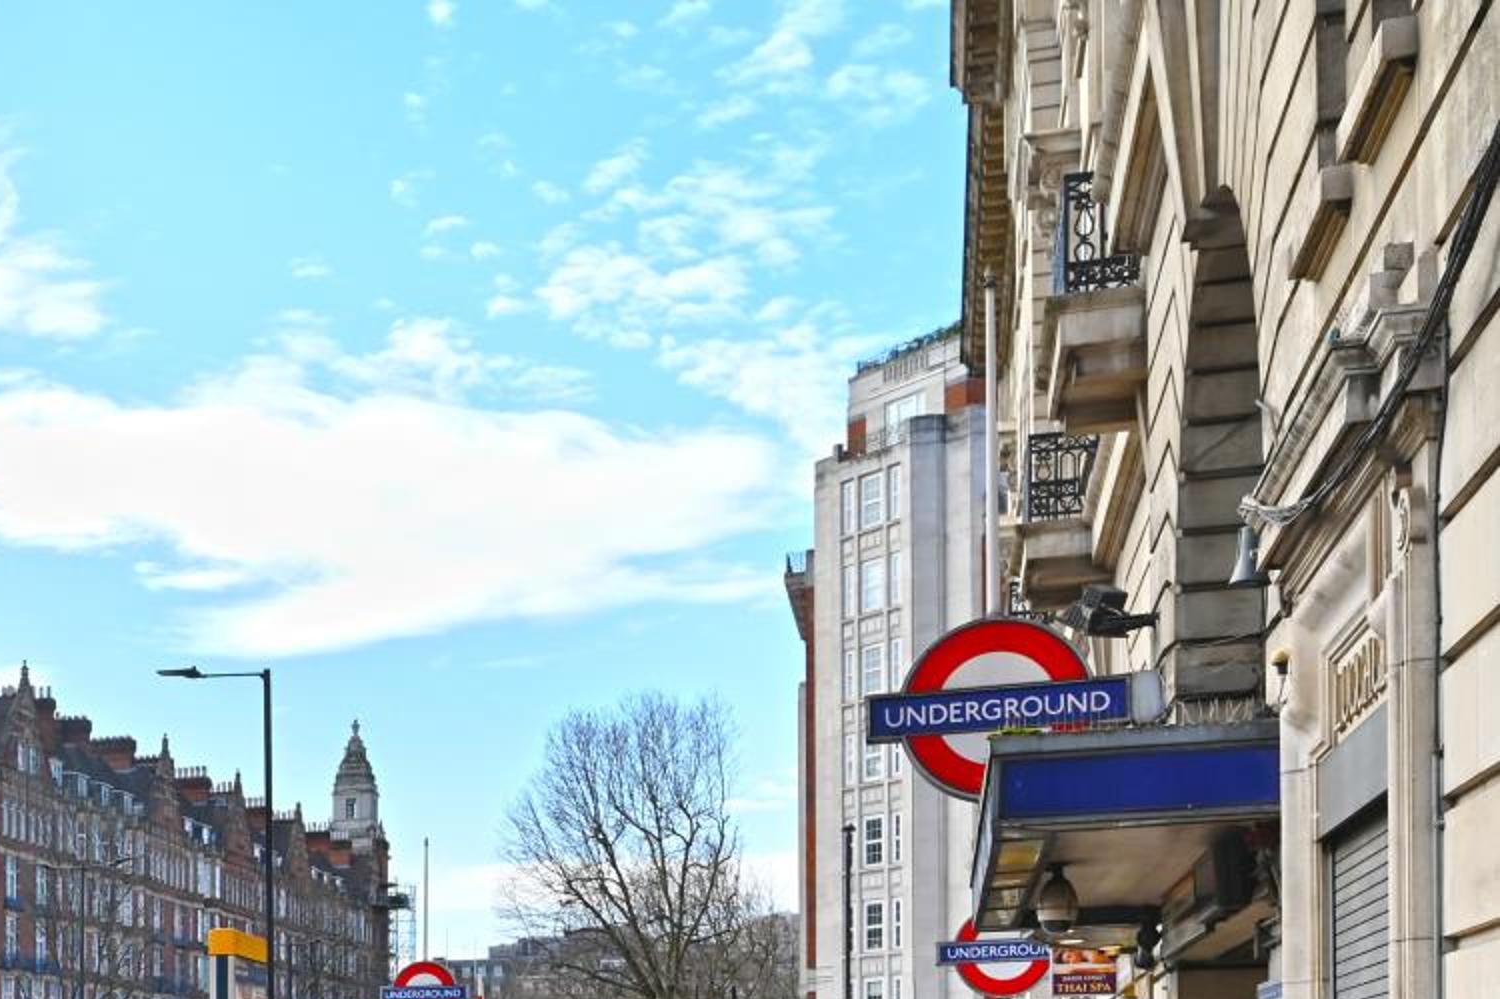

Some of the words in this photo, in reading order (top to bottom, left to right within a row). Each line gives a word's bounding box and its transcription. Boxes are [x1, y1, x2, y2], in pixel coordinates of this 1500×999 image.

[884, 690, 1111, 728] UNDERGROUND
[947, 943, 1051, 960] UNDERGROUN
[385, 988, 461, 999] UNDERGROUND
[1058, 983, 1087, 993] THAI
[1089, 982, 1111, 992] SPA
